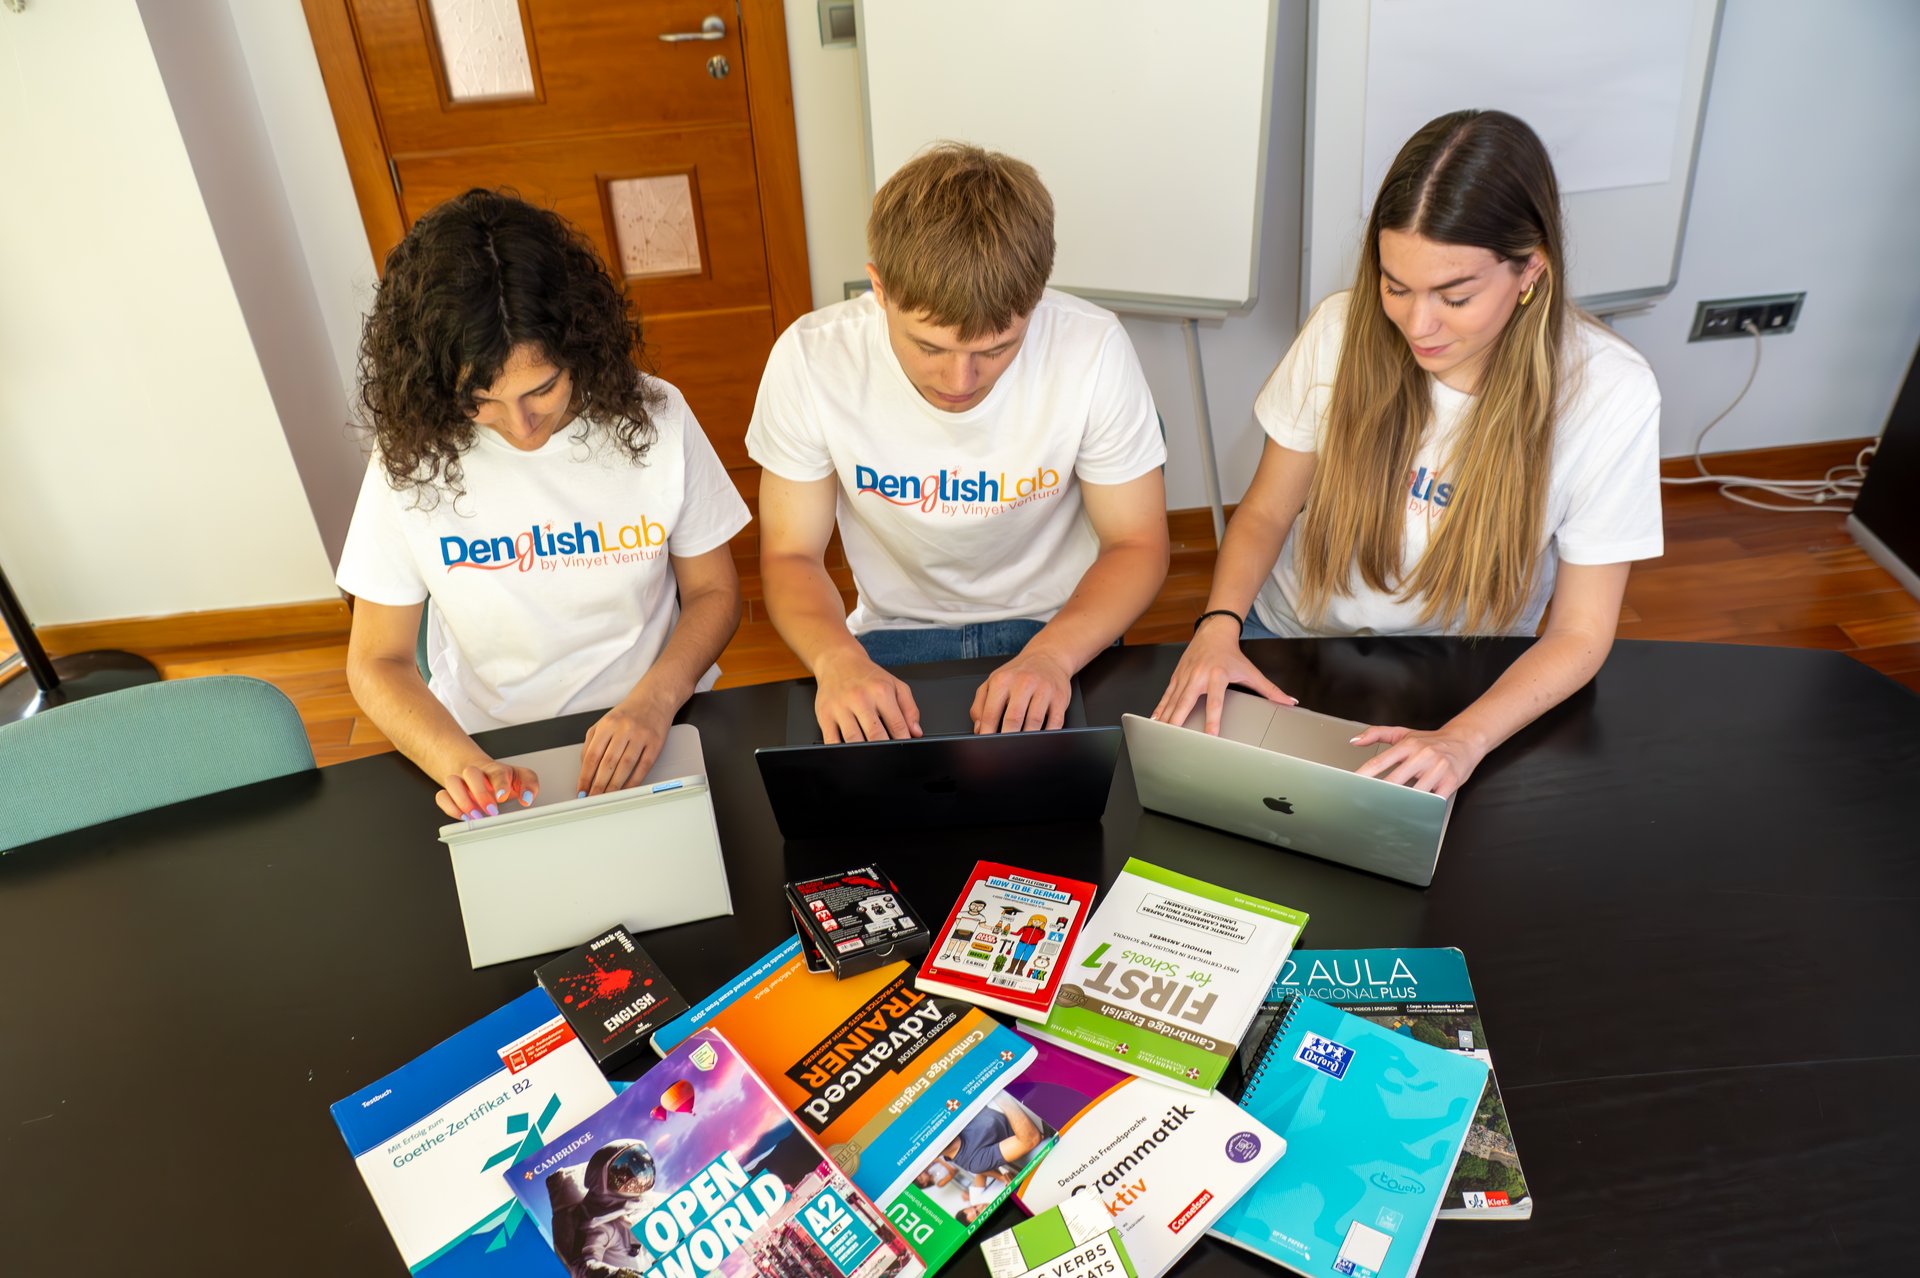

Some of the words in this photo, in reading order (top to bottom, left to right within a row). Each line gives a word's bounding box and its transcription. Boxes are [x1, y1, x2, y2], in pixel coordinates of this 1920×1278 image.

[856, 464, 1060, 513] DenglishLab
[941, 502, 958, 517] by
[962, 503, 1006, 518] Vinyet
[1009, 487, 1060, 510] Ventura
[1408, 498, 1427, 516] by
[440, 514, 666, 573] DenglishLab
[540, 558, 557, 571] by
[562, 554, 608, 569] Vinyet
[989, 878, 1010, 888] HOW
[1010, 883, 1021, 891] TO
[1021, 885, 1031, 893] BE
[1033, 886, 1066, 901] GERMAN
[1142, 907, 1165, 917] PAPERS
[1155, 904, 1181, 915] ENGLISH
[1164, 900, 1202, 915] ASSESSMENT
[1203, 912, 1233, 924] LANGUAGE
[1165, 913, 1210, 930] EXAMINATION
[1182, 912, 1219, 926] CAMBRIDGE
[1219, 923, 1239, 932] FROM
[590, 934, 616, 951] black
[614, 930, 635, 953] stories
[1113, 932, 1140, 944] SCHOOLS
[1140, 940, 1153, 948] FOR
[1149, 933, 1180, 946] ANSWERS
[1211, 927, 1245, 940] AUTHENTIC
[769, 952, 785, 964] tests
[783, 940, 801, 955] ractice
[1081, 942, 1111, 973] 1
[1152, 944, 1179, 955] ENGLISH
[1181, 943, 1212, 956] WITHOUT
[1121, 950, 1180, 977] Schools
[1187, 954, 1223, 968] CERTIFICATE
[1223, 965, 1240, 974] FIRST
[1307, 958, 1417, 985] AULA
[733, 975, 753, 993] revised
[769, 971, 791, 989] Michael
[1186, 970, 1212, 988] for
[718, 989, 734, 1003] exam
[753, 986, 771, 1000] Black
[865, 987, 895, 1012] PRACTICE
[1084, 962, 1219, 1025] FIRST
[1268, 987, 1378, 998] TERNACIONAL
[1380, 986, 1416, 998] PLUS
[604, 993, 655, 1032] ENGLISH
[690, 1009, 706, 1023] 2015
[704, 1000, 720, 1012] from
[1101, 1005, 1146, 1027] English
[848, 1011, 867, 1027] TESTS
[926, 1012, 957, 1039] SECOND
[802, 985, 924, 1087] TRAINER
[832, 1026, 849, 1041] WITH
[1050, 1024, 1080, 1040] ENGLISH
[1078, 1033, 1118, 1052] CAMBRIDGE
[1147, 1020, 1218, 1051] Cambridge
[802, 1039, 832, 1066] ANSWERS
[897, 1036, 928, 1064] EDITION
[926, 1030, 984, 1078] Cambridge
[1304, 1049, 1339, 1072] Oxford
[806, 1001, 941, 1122] Advanced
[1137, 1054, 1186, 1075] CAMBRIDGE
[965, 1060, 1004, 1095] CAMBRIDGE
[361, 1089, 392, 1108] Testbuch
[888, 1077, 930, 1114] English
[393, 1092, 510, 1168] Goethe-Zertifikat
[512, 1078, 532, 1095] B2
[918, 1111, 951, 1142] CAMBRIDGE
[387, 1143, 402, 1154] Mit
[402, 1128, 427, 1146] Erfolg
[428, 1118, 445, 1131] zum
[534, 1132, 593, 1175] CAMBRIDGE
[896, 1141, 921, 1166] ENGLISH
[1057, 1163, 1089, 1187] Deutsch
[1088, 1155, 1100, 1165] als
[1098, 1117, 1147, 1156] Fremdsprache
[645, 1152, 748, 1252] OPEN
[977, 1189, 1017, 1218] DEUTSCH
[1104, 1177, 1148, 1217] ktiv
[1487, 1198, 1508, 1207] Klett
[805, 1194, 847, 1236] A2
[880, 1198, 934, 1244] DEU
[1171, 1192, 1212, 1231] Cornelsen
[648, 1172, 788, 1278] WORLD
[830, 1223, 842, 1236] KEY
[967, 1224, 976, 1236] C1
[1052, 1243, 1107, 1278] VERBS
